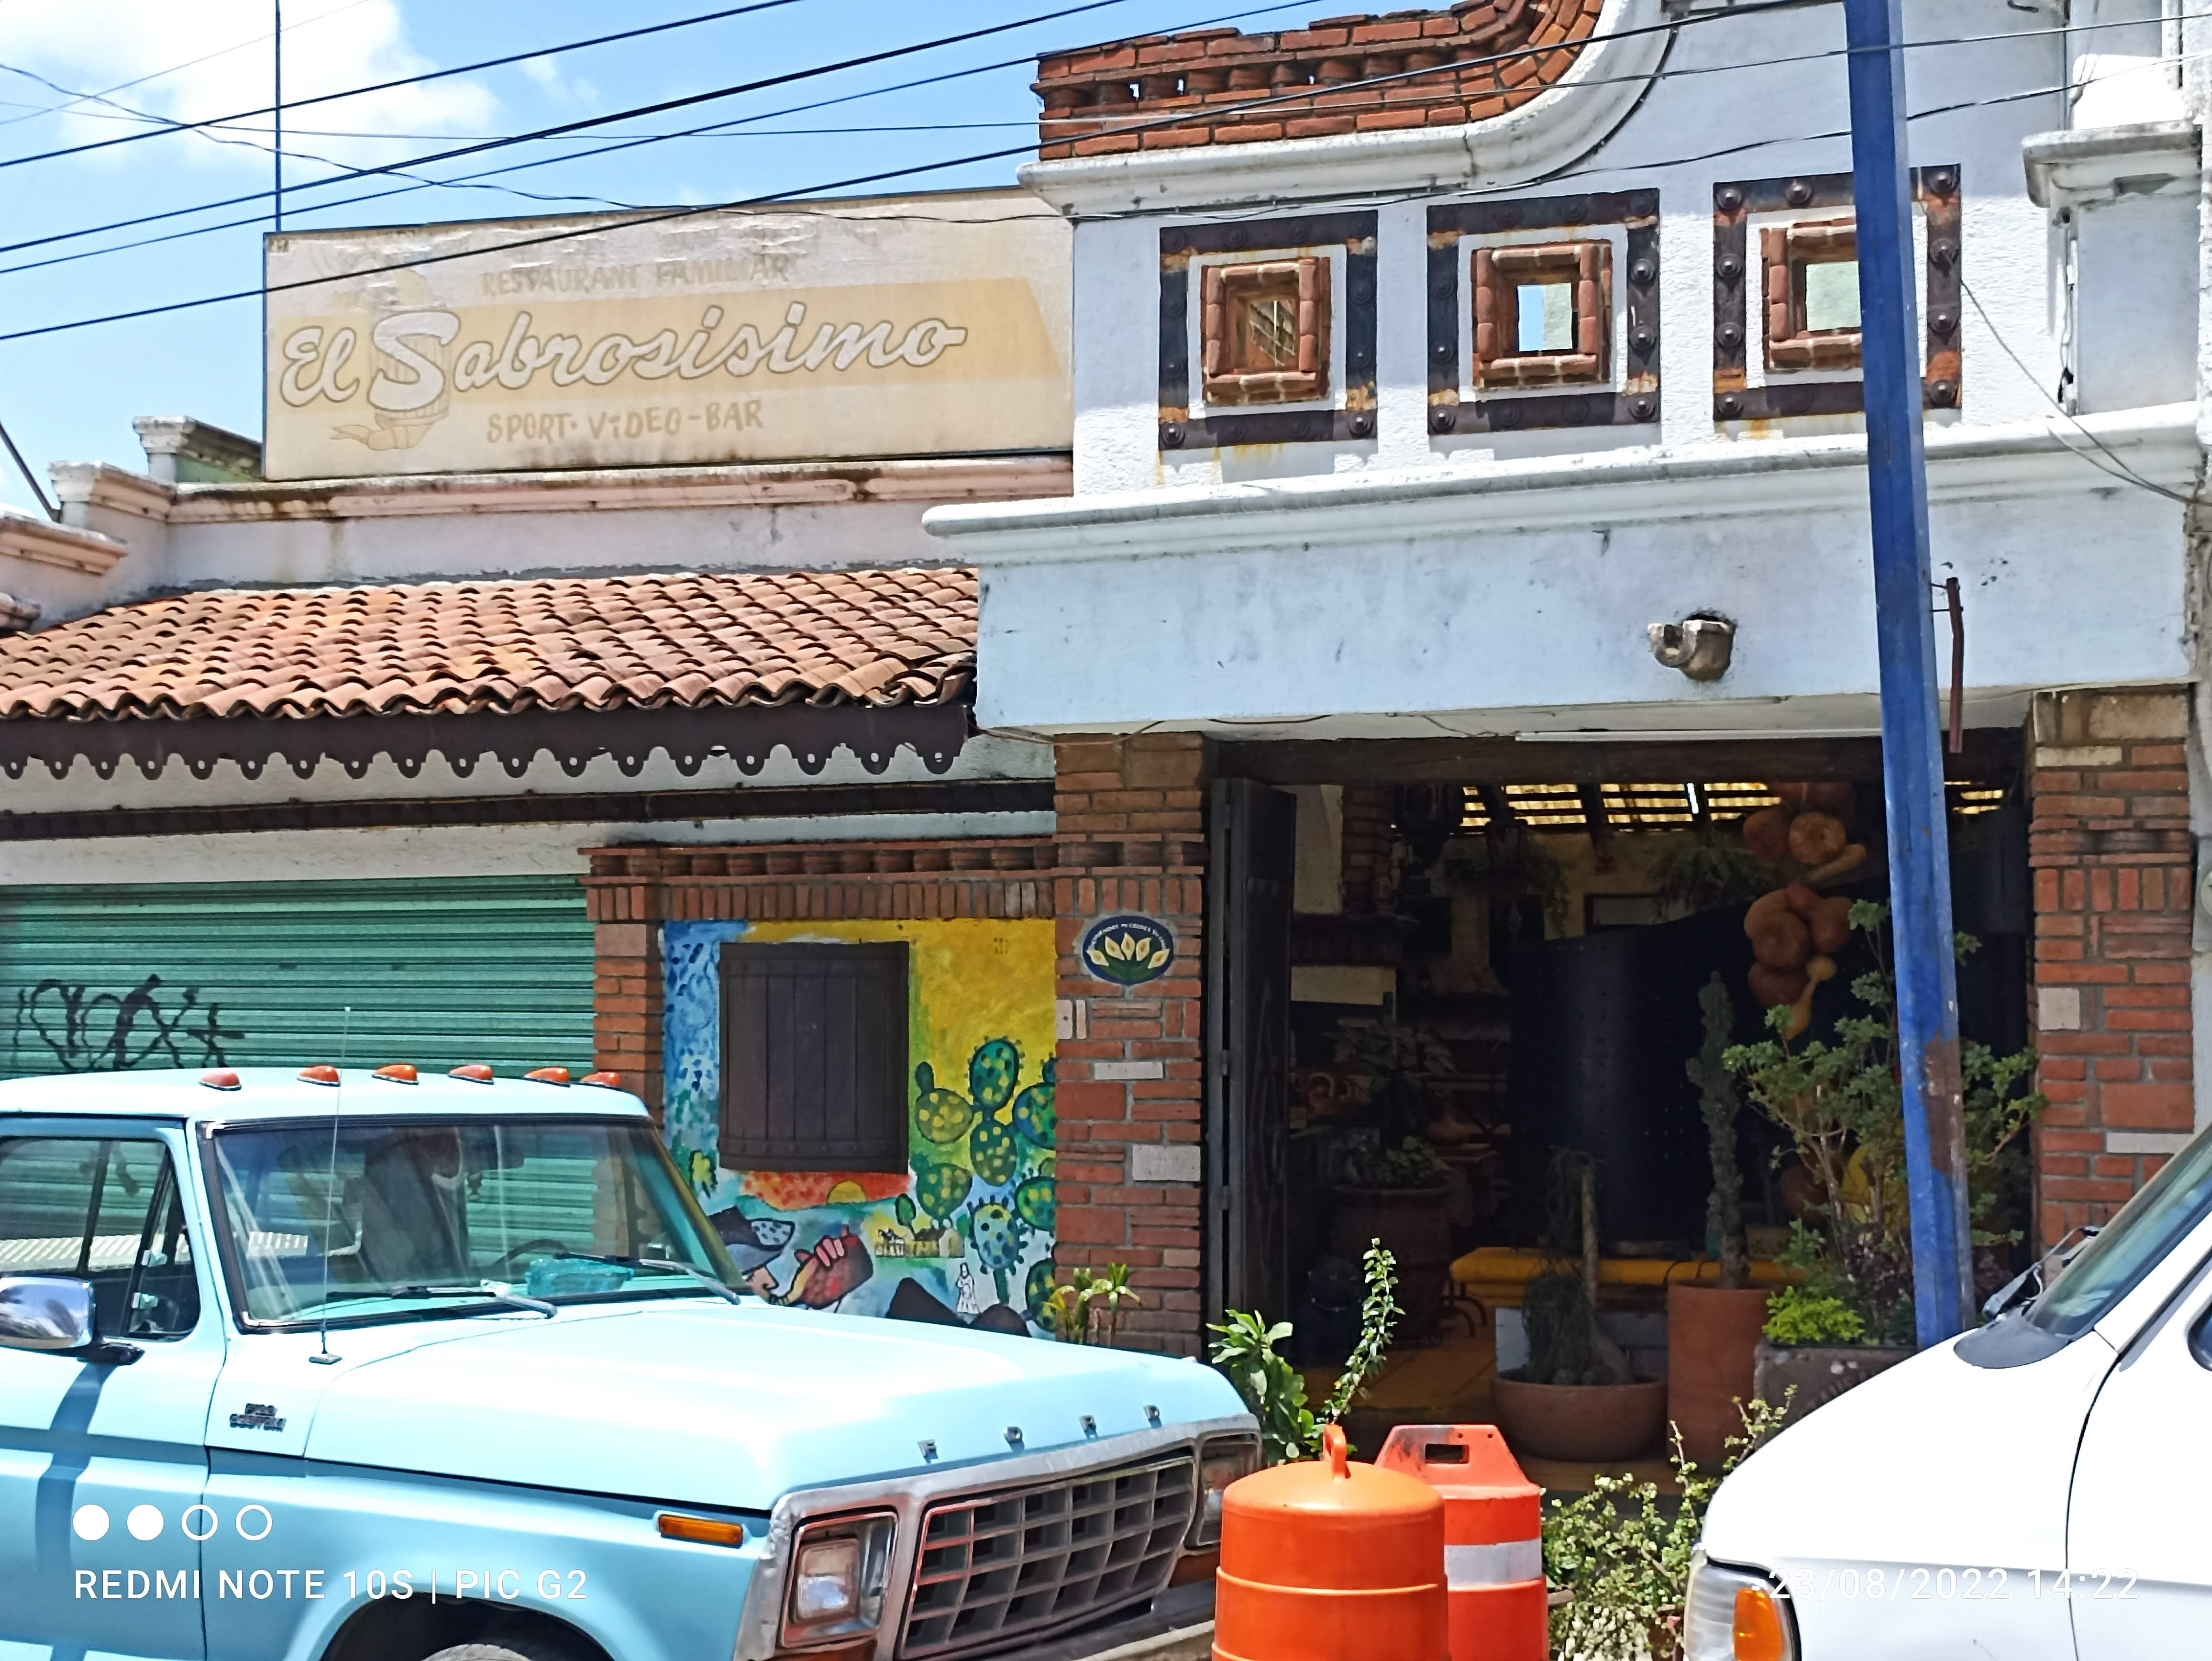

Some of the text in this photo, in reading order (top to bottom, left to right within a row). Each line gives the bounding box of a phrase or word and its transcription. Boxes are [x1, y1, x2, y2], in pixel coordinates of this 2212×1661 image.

[482, 264, 642, 297] RESTAURANT
[280, 301, 968, 412] El Sabrosisimo
[917, 1404, 1161, 1458] FORD
